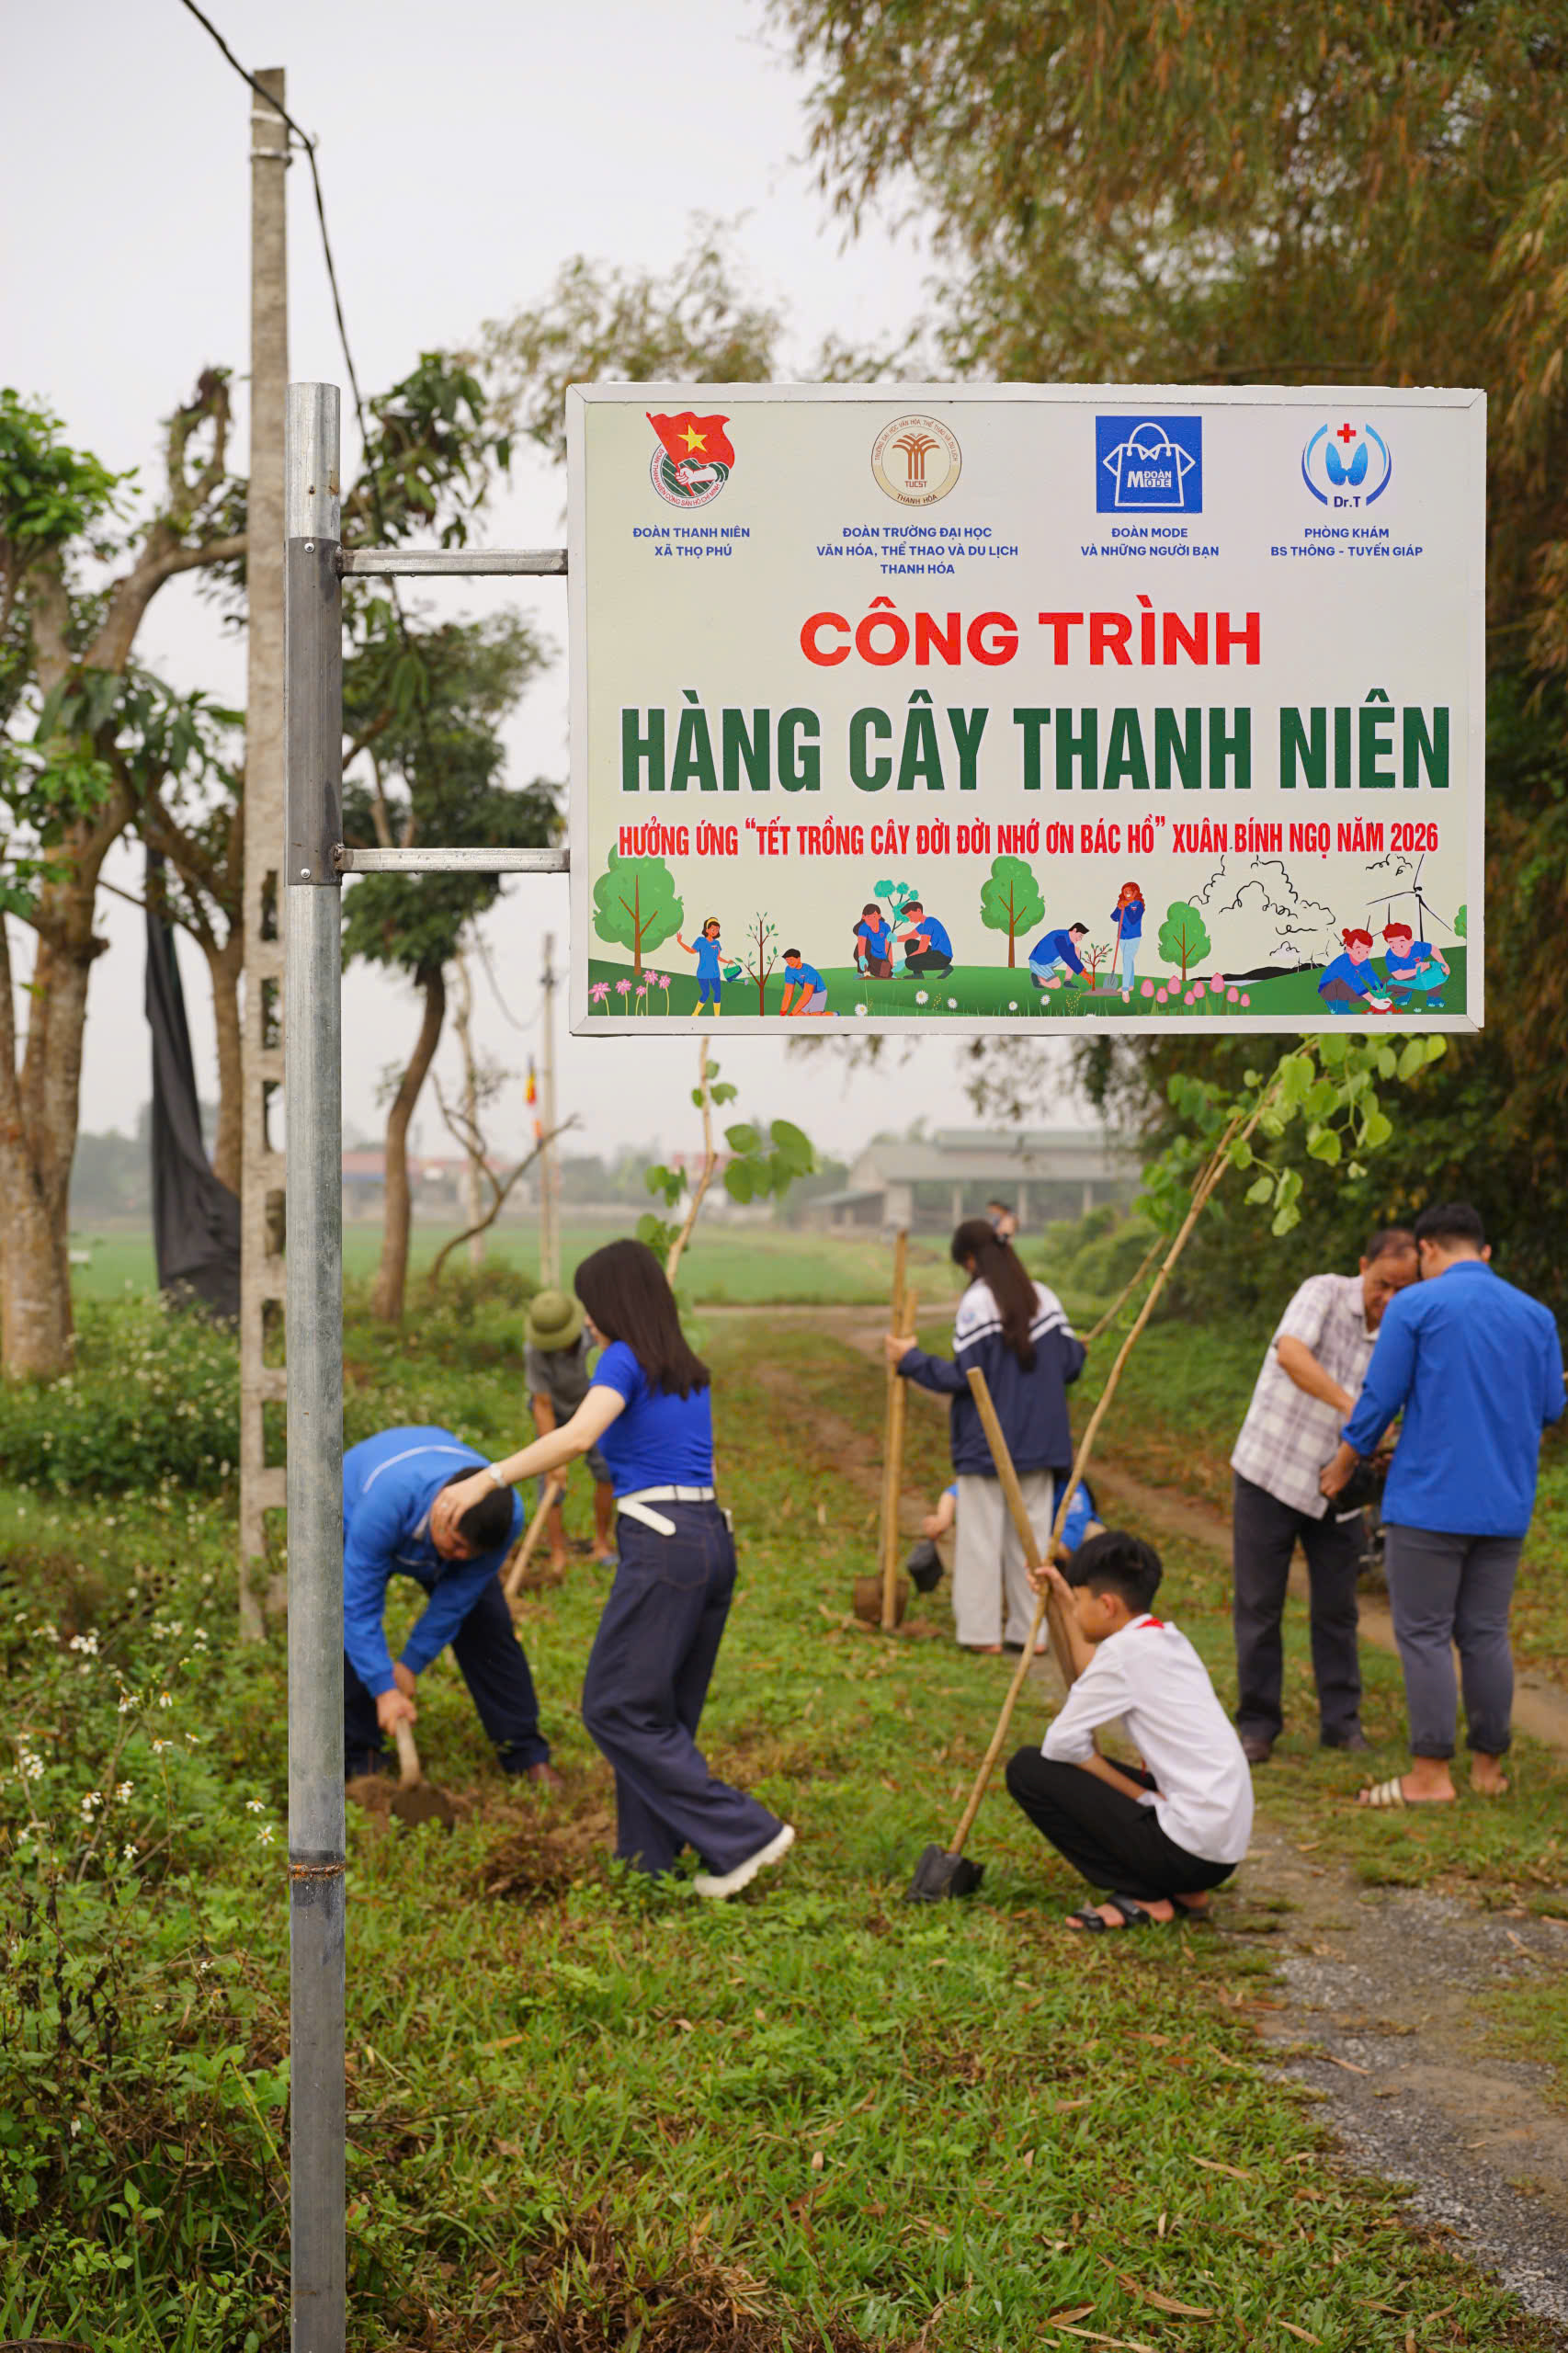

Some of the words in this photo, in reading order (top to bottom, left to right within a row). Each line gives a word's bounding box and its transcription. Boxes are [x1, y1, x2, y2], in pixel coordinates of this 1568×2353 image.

[896, 493, 920, 505] THANH
[1334, 496, 1361, 507] Dr.T
[632, 525, 670, 537] ĐOÀN
[673, 528, 717, 537] THANH
[721, 525, 750, 537] NIÊN
[842, 524, 880, 537] ĐOÀN
[882, 524, 937, 537] TRƯỜNG
[939, 527, 961, 540] ĐẠI
[964, 527, 992, 540] HỌC
[1111, 525, 1148, 537] ĐOÀN
[1151, 528, 1188, 537] MODE
[1304, 525, 1349, 538] PHÒNG
[1352, 525, 1389, 538] KHÁM
[654, 544, 673, 556] XÃ
[676, 546, 703, 559] THỌ
[706, 543, 732, 556] PHÚ
[816, 544, 843, 556] VĂN
[846, 543, 878, 557] HÓA,
[881, 541, 905, 556] THỂ
[909, 546, 945, 556] THAO
[948, 543, 965, 556] VÀ
[968, 546, 986, 556] DU
[989, 546, 1018, 559] LỊCH
[1081, 543, 1098, 556] VÀ
[1101, 543, 1147, 556] NHỮNG
[1149, 543, 1190, 556] NGƯỜI
[1193, 546, 1219, 559] BẠN
[1271, 546, 1287, 556] BS
[1290, 544, 1335, 556] THÔNG
[1348, 542, 1390, 556] TUYẾN
[1392, 544, 1423, 556] GIÁP
[881, 564, 924, 574] THANH
[927, 561, 955, 574] HÓA
[801, 597, 1018, 666] CÔNG
[1039, 595, 1260, 665] TRÌNH
[622, 690, 820, 791] HÀNG
[850, 689, 988, 790] CÂY
[1013, 708, 1251, 790] THANH
[1280, 688, 1449, 788] NIÊN
[619, 816, 689, 856] HƯỞNG
[696, 820, 738, 856] ỨNG
[745, 816, 790, 855] “TẾT
[797, 815, 864, 855] TRỒNG
[871, 819, 910, 855] CÂY
[916, 817, 949, 855] ĐỜI
[957, 817, 990, 855] ĐỜI
[997, 818, 1040, 854] NHỚ
[1046, 822, 1074, 854] ƠN
[1081, 818, 1120, 854] BÁC
[1128, 813, 1165, 853] HỒ”
[1173, 817, 1227, 853] XUÂN
[1235, 817, 1282, 853] BÍNH
[1290, 823, 1330, 858] NGỌ
[1338, 816, 1383, 852] NĂM
[1391, 823, 1438, 852] 2026
